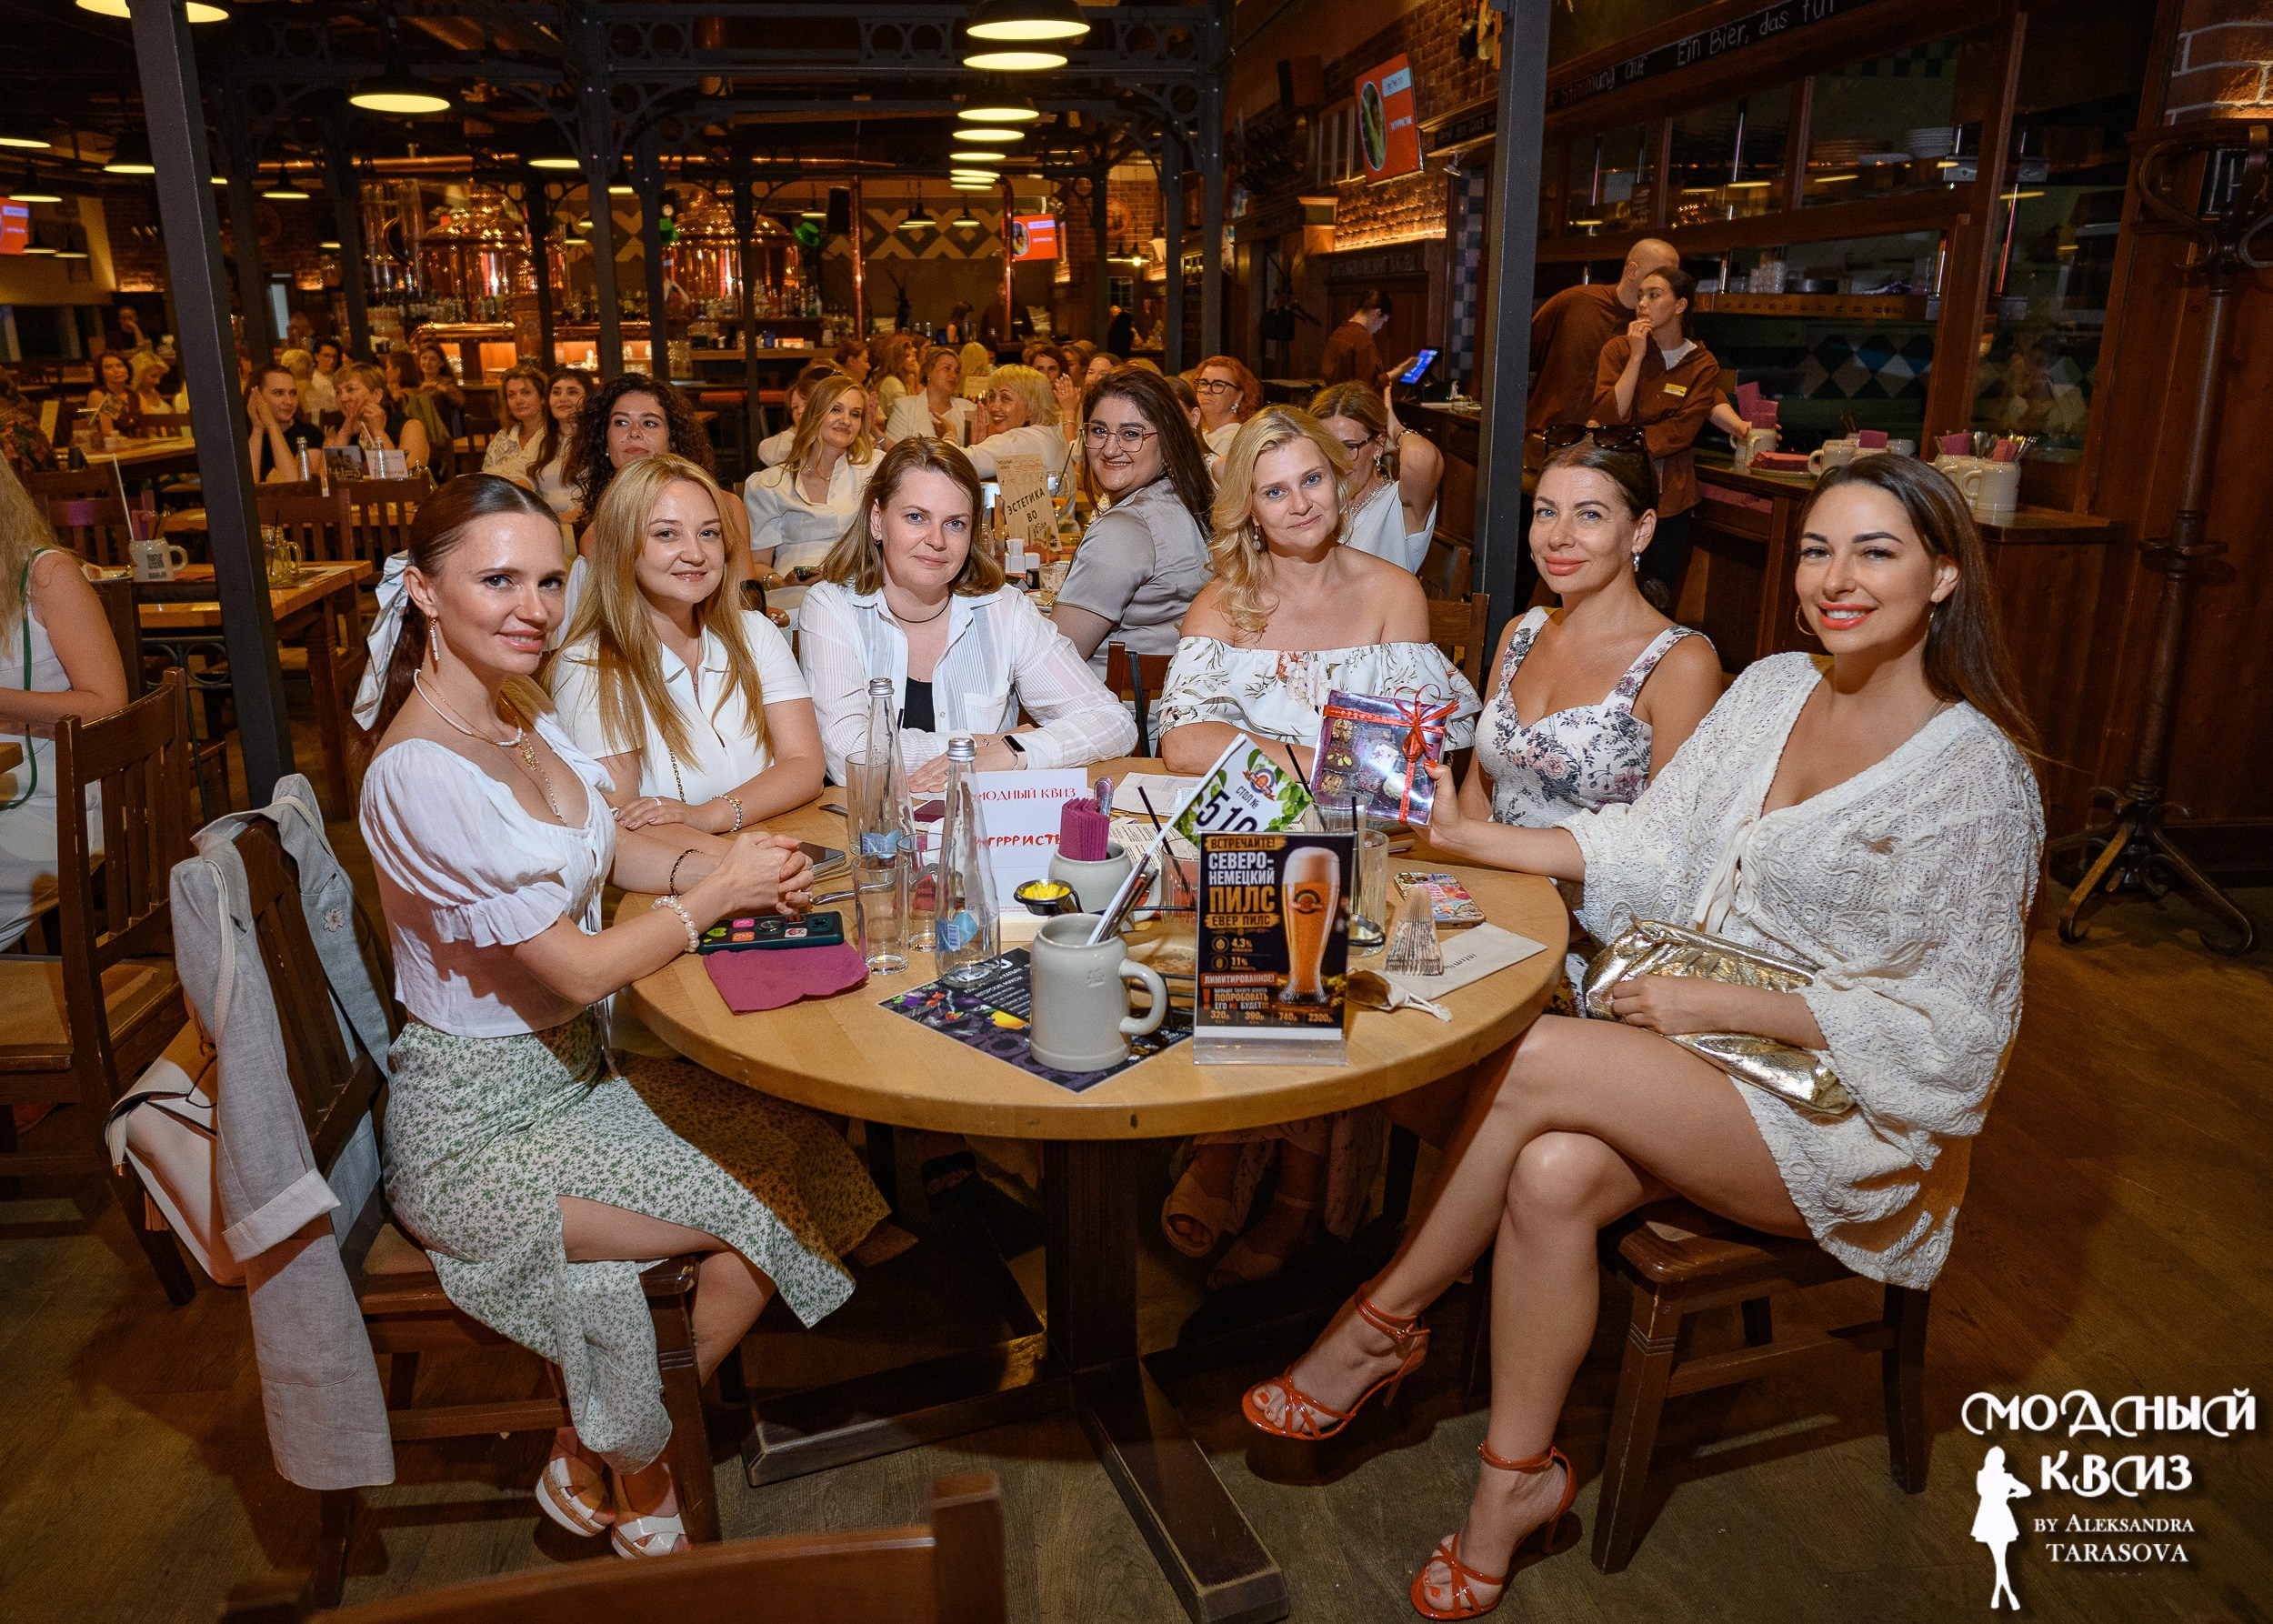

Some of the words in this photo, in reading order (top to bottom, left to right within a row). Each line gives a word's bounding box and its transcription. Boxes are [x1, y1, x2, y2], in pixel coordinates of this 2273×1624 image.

[1625, 56, 1647, 80] auf
[1677, 38, 1701, 65] Ein
[1709, 23, 1749, 55] Bier,
[1759, 8, 1789, 35] das
[1006, 487, 1046, 516] ЭСТЕТИКА
[1026, 511, 1037, 523] ВО
[1041, 787, 1076, 798] КВИЗ
[1236, 786, 1253, 804] СТОЛ
[1208, 851, 1275, 870] СЕВЕРО-
[1208, 867, 1275, 886] НЕМЕЦКИЙ
[1208, 886, 1276, 913] ПИЛС
[1212, 916, 1238, 927] ЕВЕР
[1243, 915, 1270, 926] ПИЛС
[1231, 937, 1253, 949] 4,3%
[1231, 957, 1248, 967] 11%
[1205, 974, 1275, 984] ЛИМИТИРОВАННОЕ!
[1214, 993, 1269, 1002] ПОПРОБОВАТЬ
[1215, 1002, 1227, 1010] ЕГО
